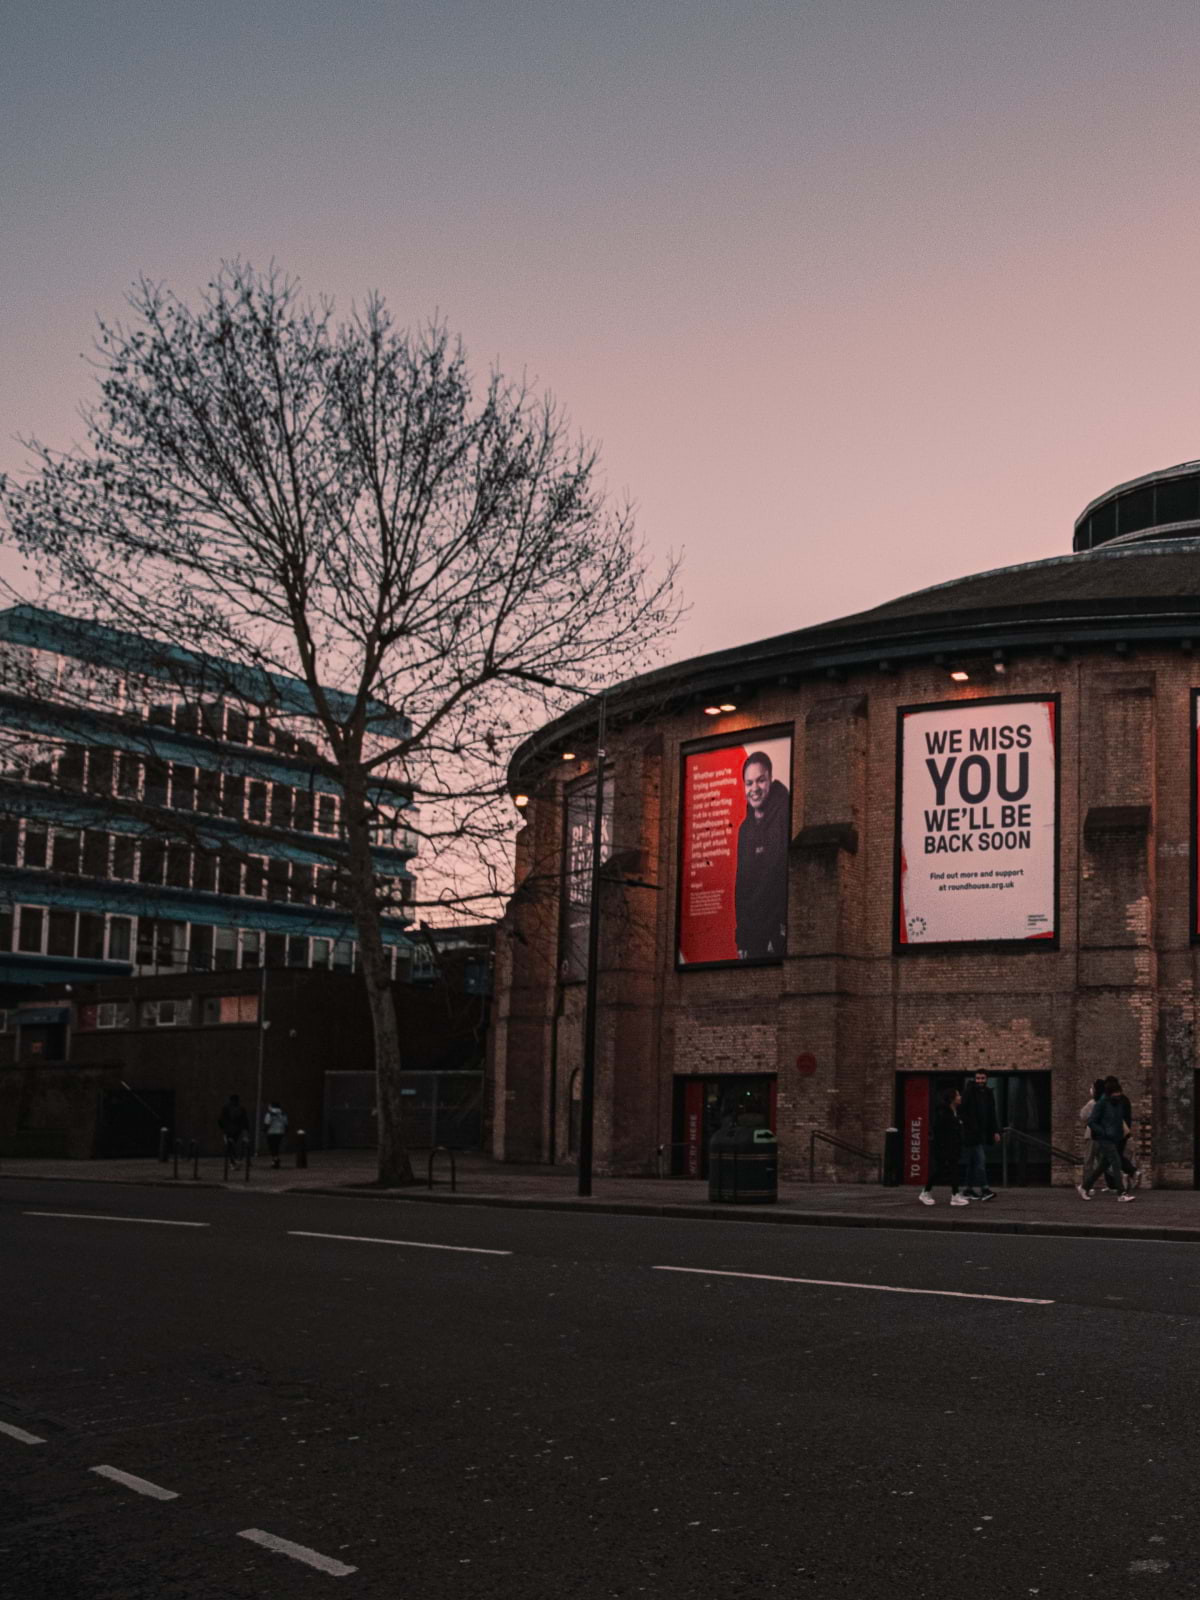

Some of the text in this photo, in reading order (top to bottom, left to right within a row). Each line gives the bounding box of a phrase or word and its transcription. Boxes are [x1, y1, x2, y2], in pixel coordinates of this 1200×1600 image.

[925, 725, 1032, 755] WE MISS
[715, 768, 732, 777] you're
[709, 777, 737, 787] something
[925, 752, 1029, 806] YOU
[711, 798, 732, 807] starting
[924, 804, 1031, 832] WE'LL BE
[711, 829, 725, 838] place
[726, 827, 732, 835] to
[703, 840, 712, 850] get
[712, 838, 727, 846] stuck
[925, 831, 1030, 854] BACK SOON
[702, 848, 730, 857] something
[930, 872, 944, 880] Find
[947, 872, 958, 880] out
[980, 870, 993, 878] and
[995, 869, 1023, 880] support
[948, 881, 1014, 891] roundhouse.org.uk
[910, 1117, 923, 1178] TO CREATE,
